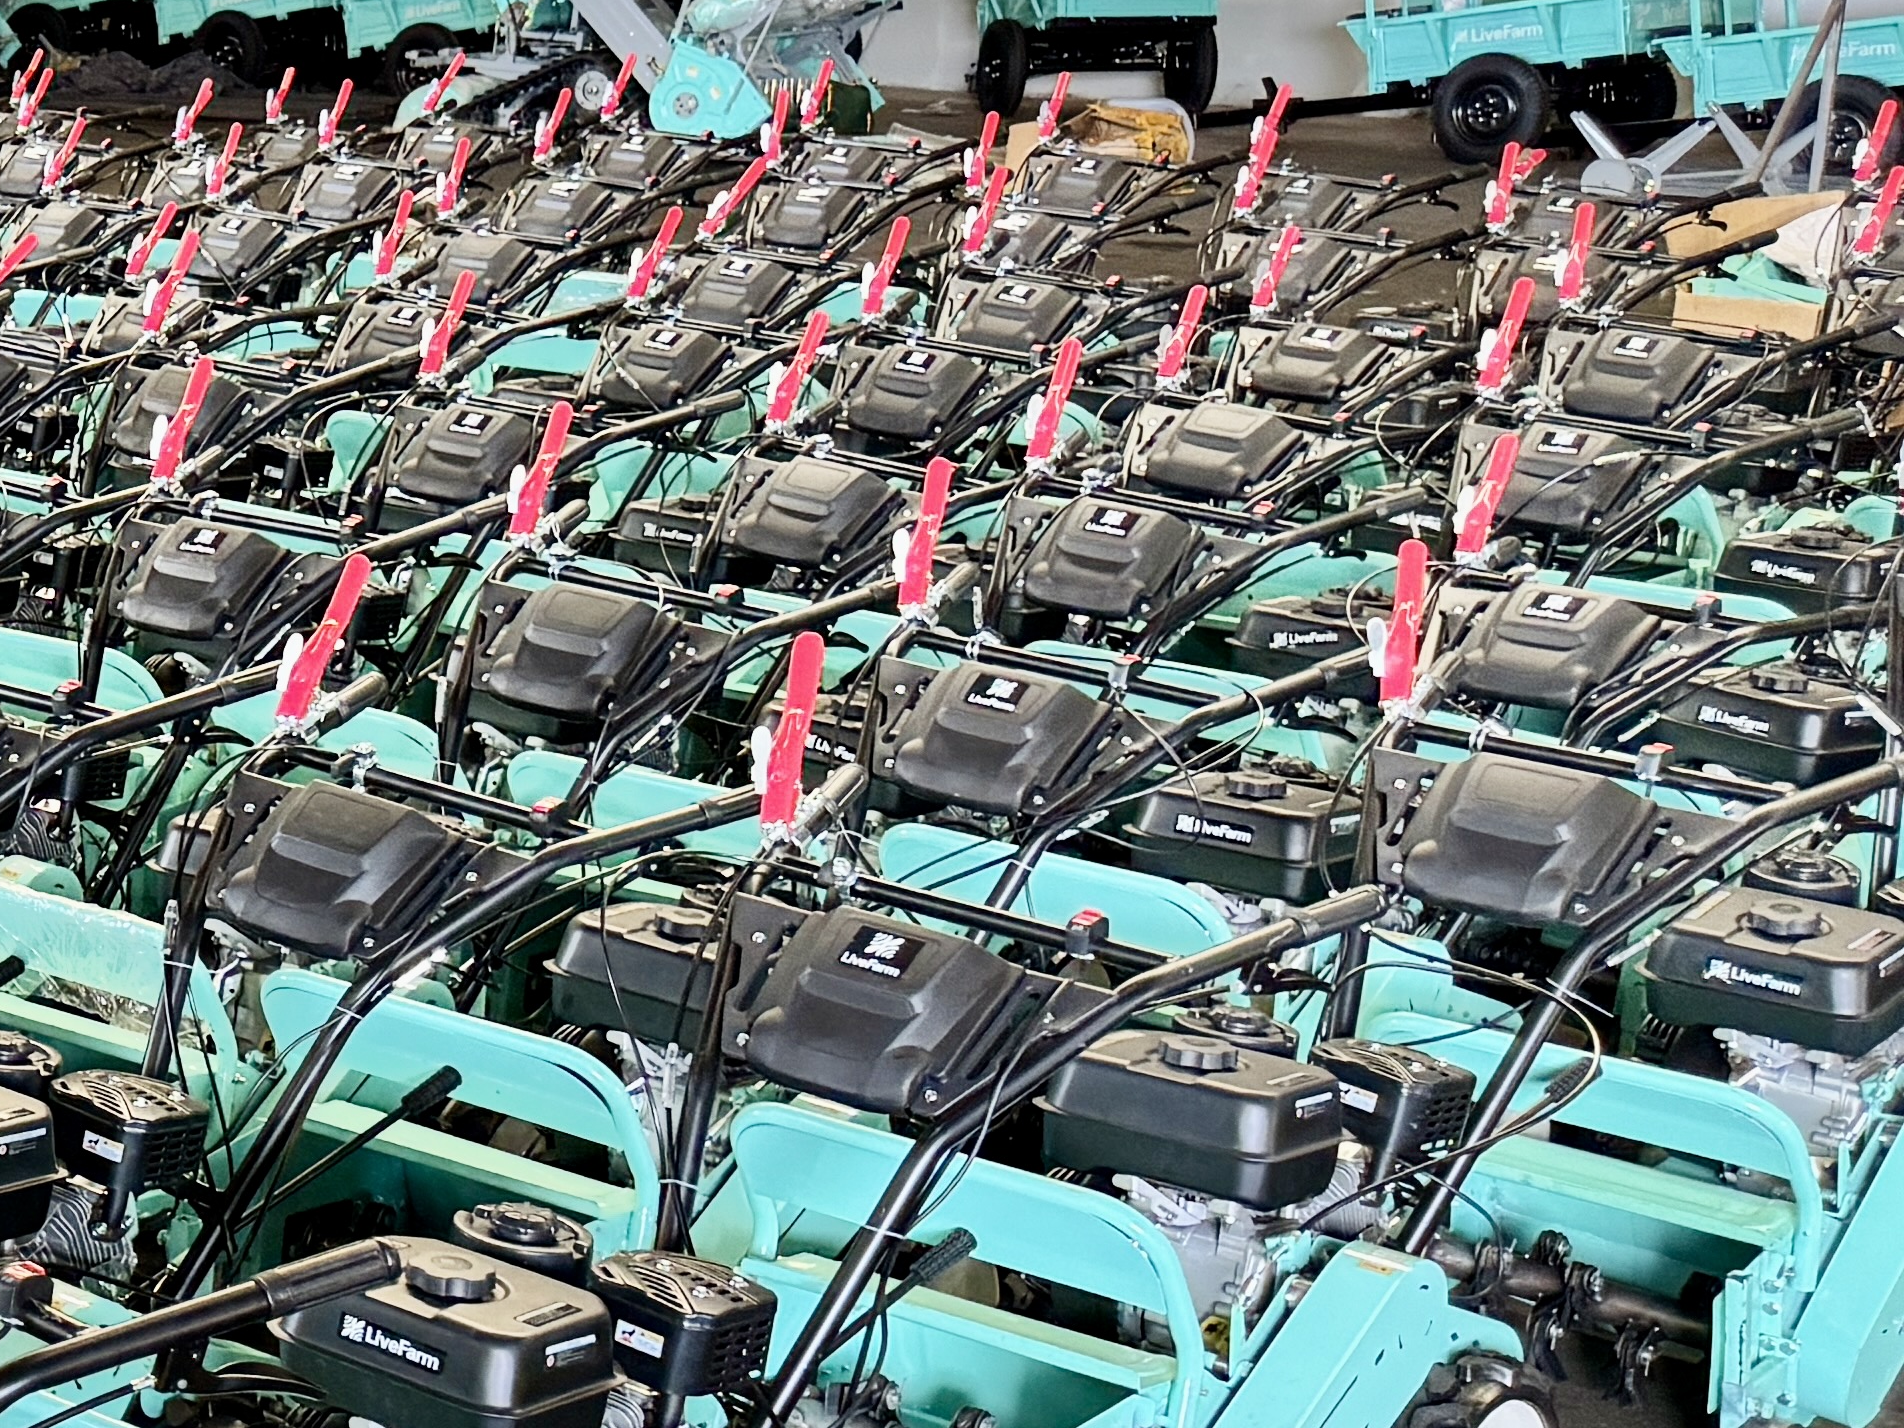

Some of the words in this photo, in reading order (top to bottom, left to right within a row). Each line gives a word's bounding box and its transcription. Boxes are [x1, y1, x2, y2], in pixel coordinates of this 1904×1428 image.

[1470, 23, 1544, 44] LiveFarm
[1731, 966, 1801, 996] LiveFarm
[364, 1326, 440, 1371] LiveFarm
